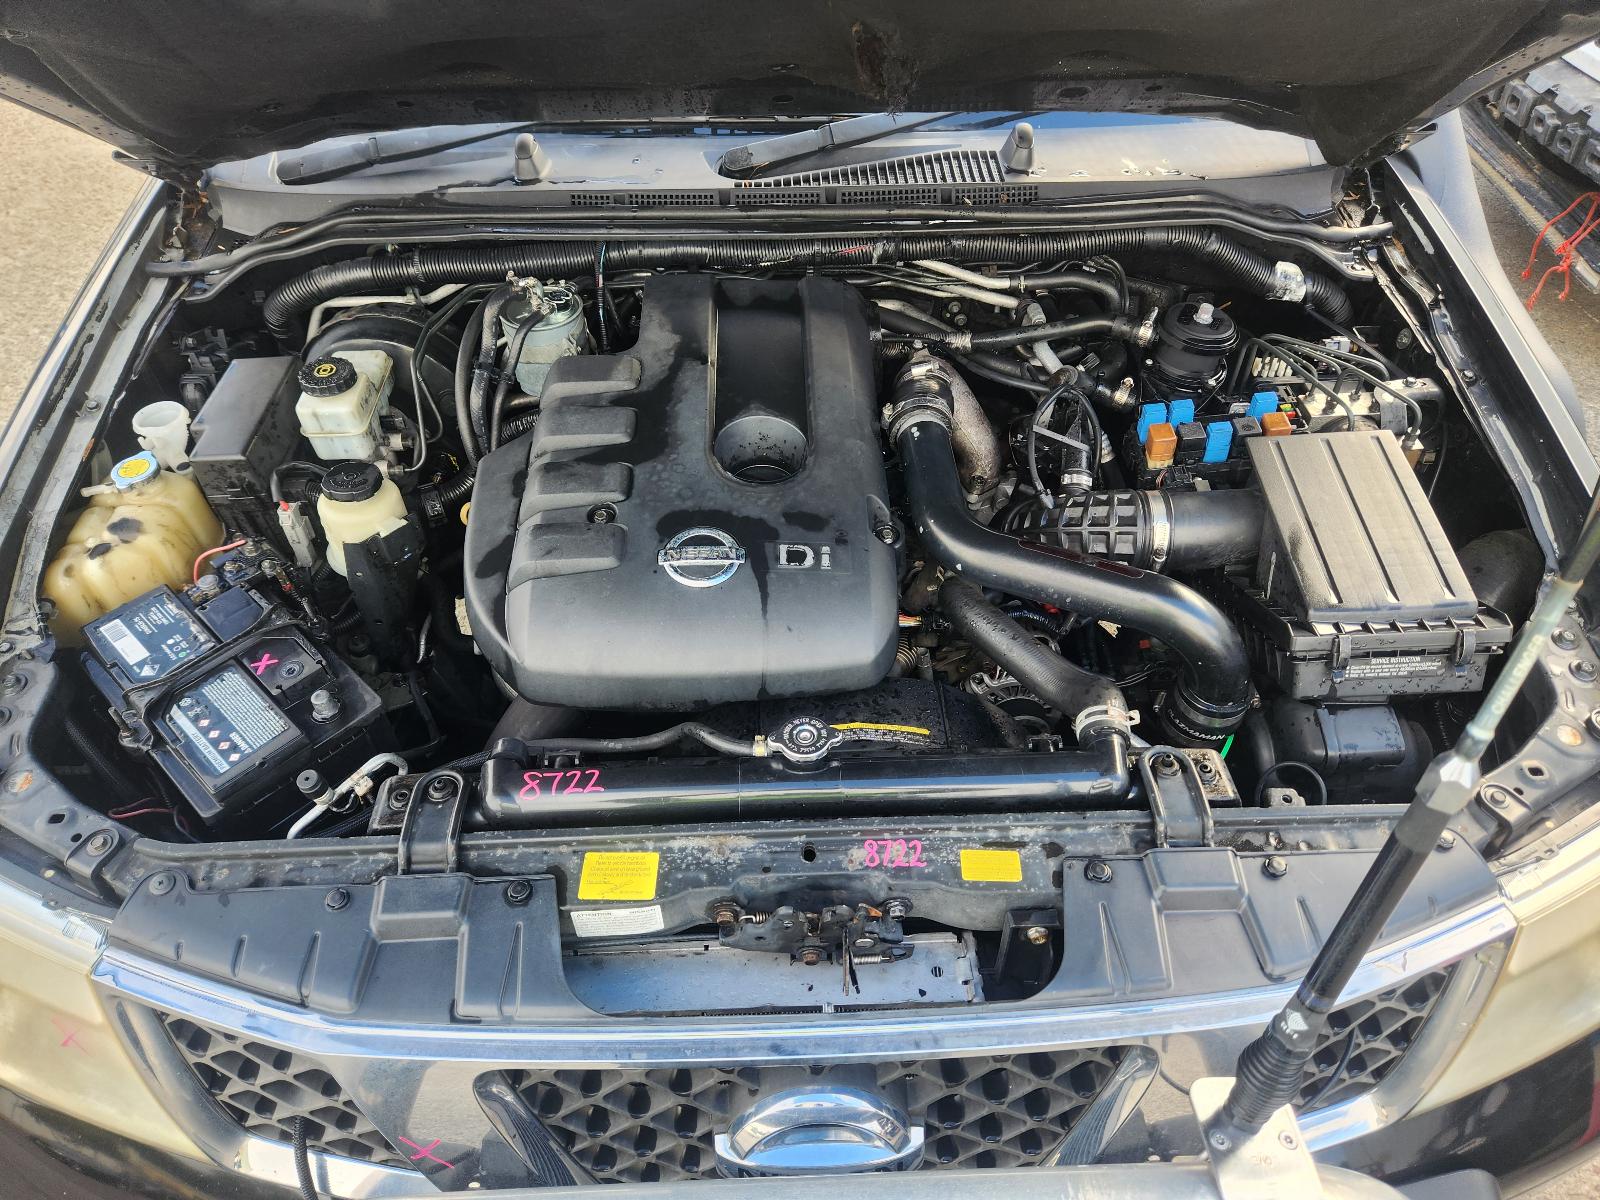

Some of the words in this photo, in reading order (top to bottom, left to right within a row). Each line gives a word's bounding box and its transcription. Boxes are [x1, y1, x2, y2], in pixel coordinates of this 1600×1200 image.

[666, 547, 737, 561] NISSAN
[778, 544, 831, 570] Di
[1491, 634, 1544, 715] CHALLENGER
[190, 731, 210, 752] BATTERY
[519, 769, 605, 801] 8722
[863, 838, 929, 868] 8722
